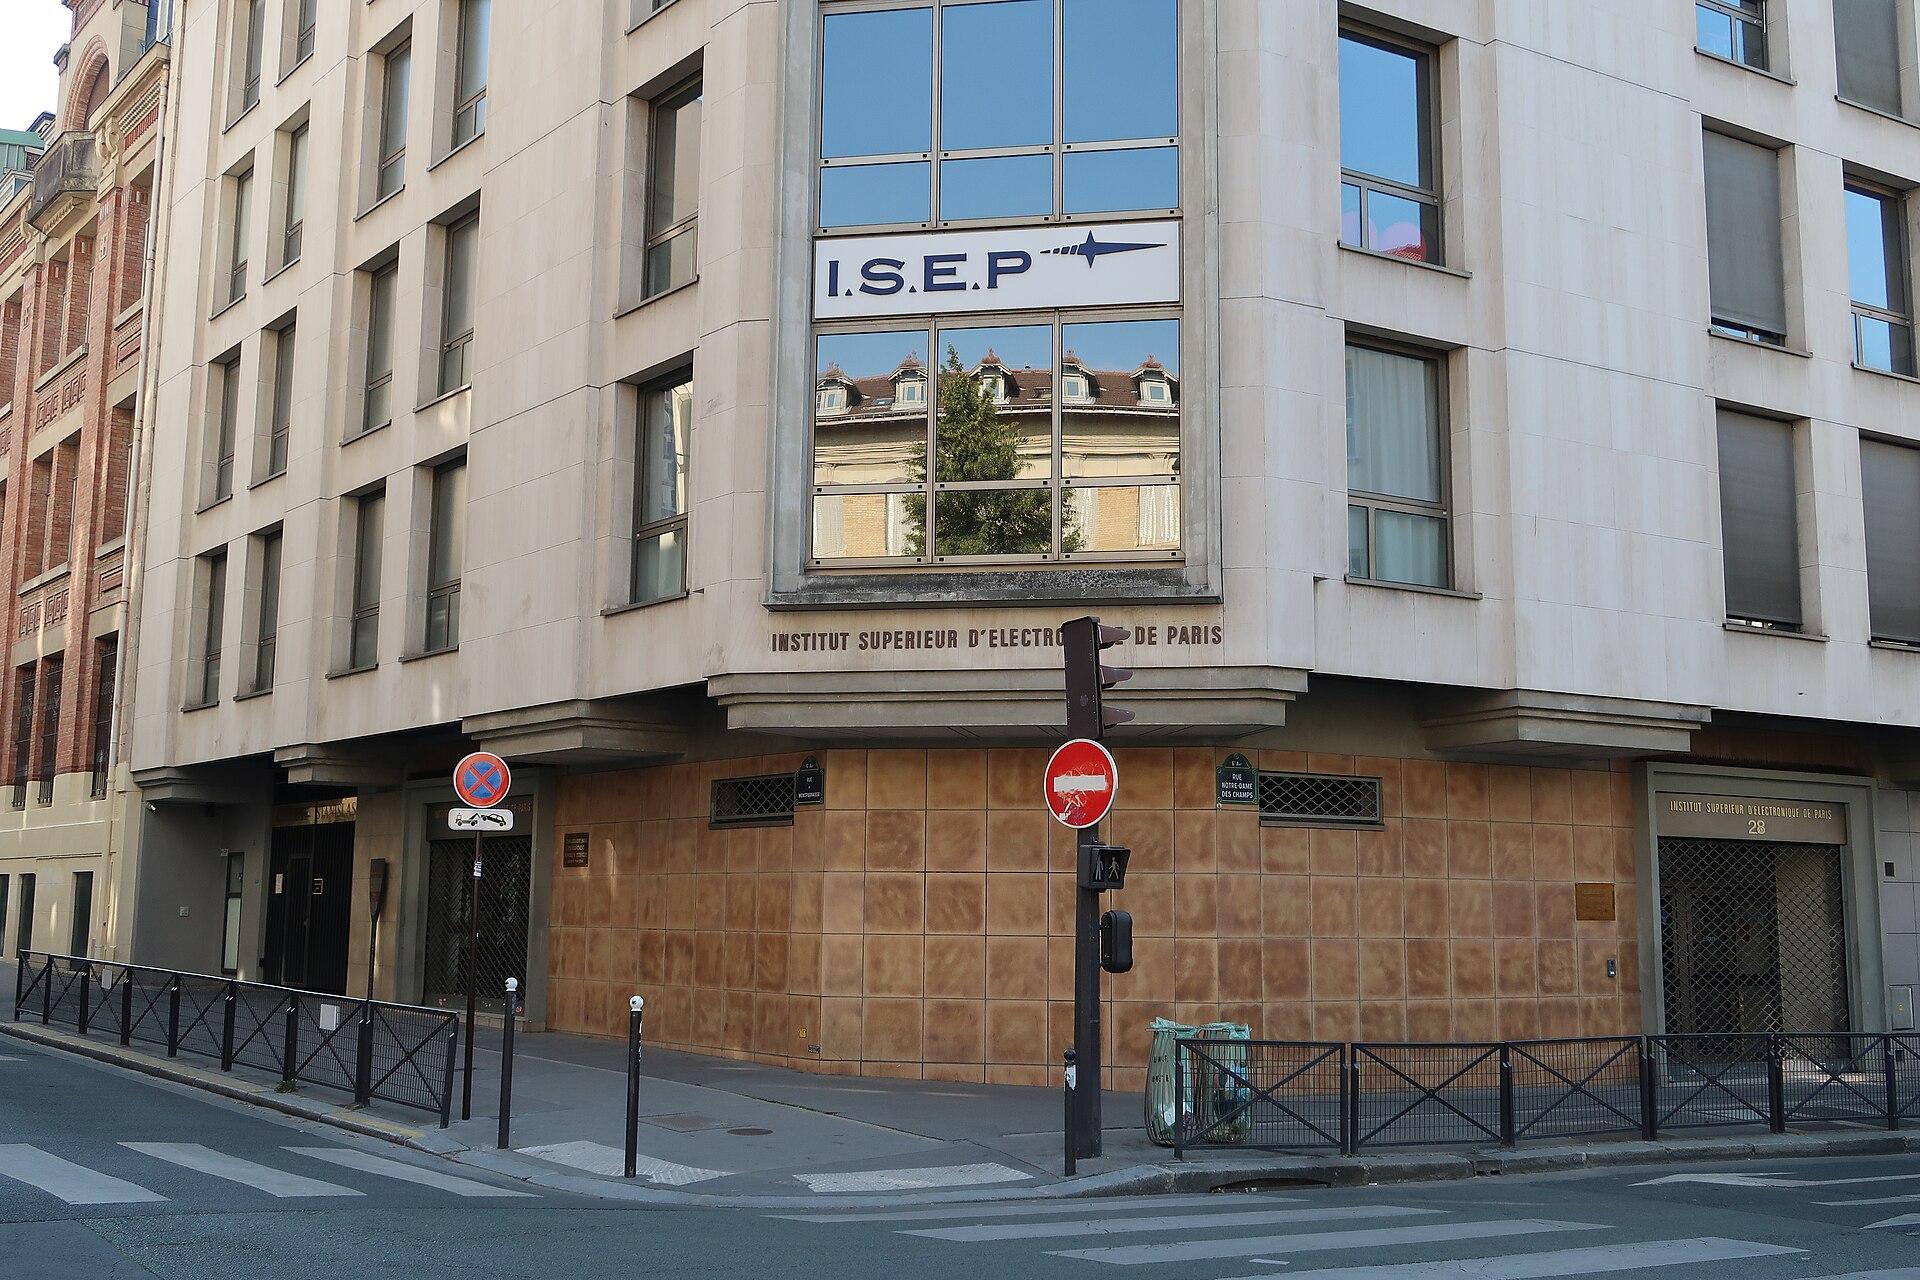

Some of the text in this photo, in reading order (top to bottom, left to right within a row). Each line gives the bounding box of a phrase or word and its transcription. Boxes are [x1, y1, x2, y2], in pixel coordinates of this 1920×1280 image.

[772, 625, 1222, 651] INSTITUT SUPERIEUR D'ELECTRO DE PARIS
[1221, 782, 1253, 790] NOTRE-DAME
[1221, 790, 1254, 799] DES CHAMPS
[1670, 800, 1832, 820] INSTITUT SUPERIEUR D'ELECTRONIQUE DE PARIS
[1748, 819, 1766, 835] 28
